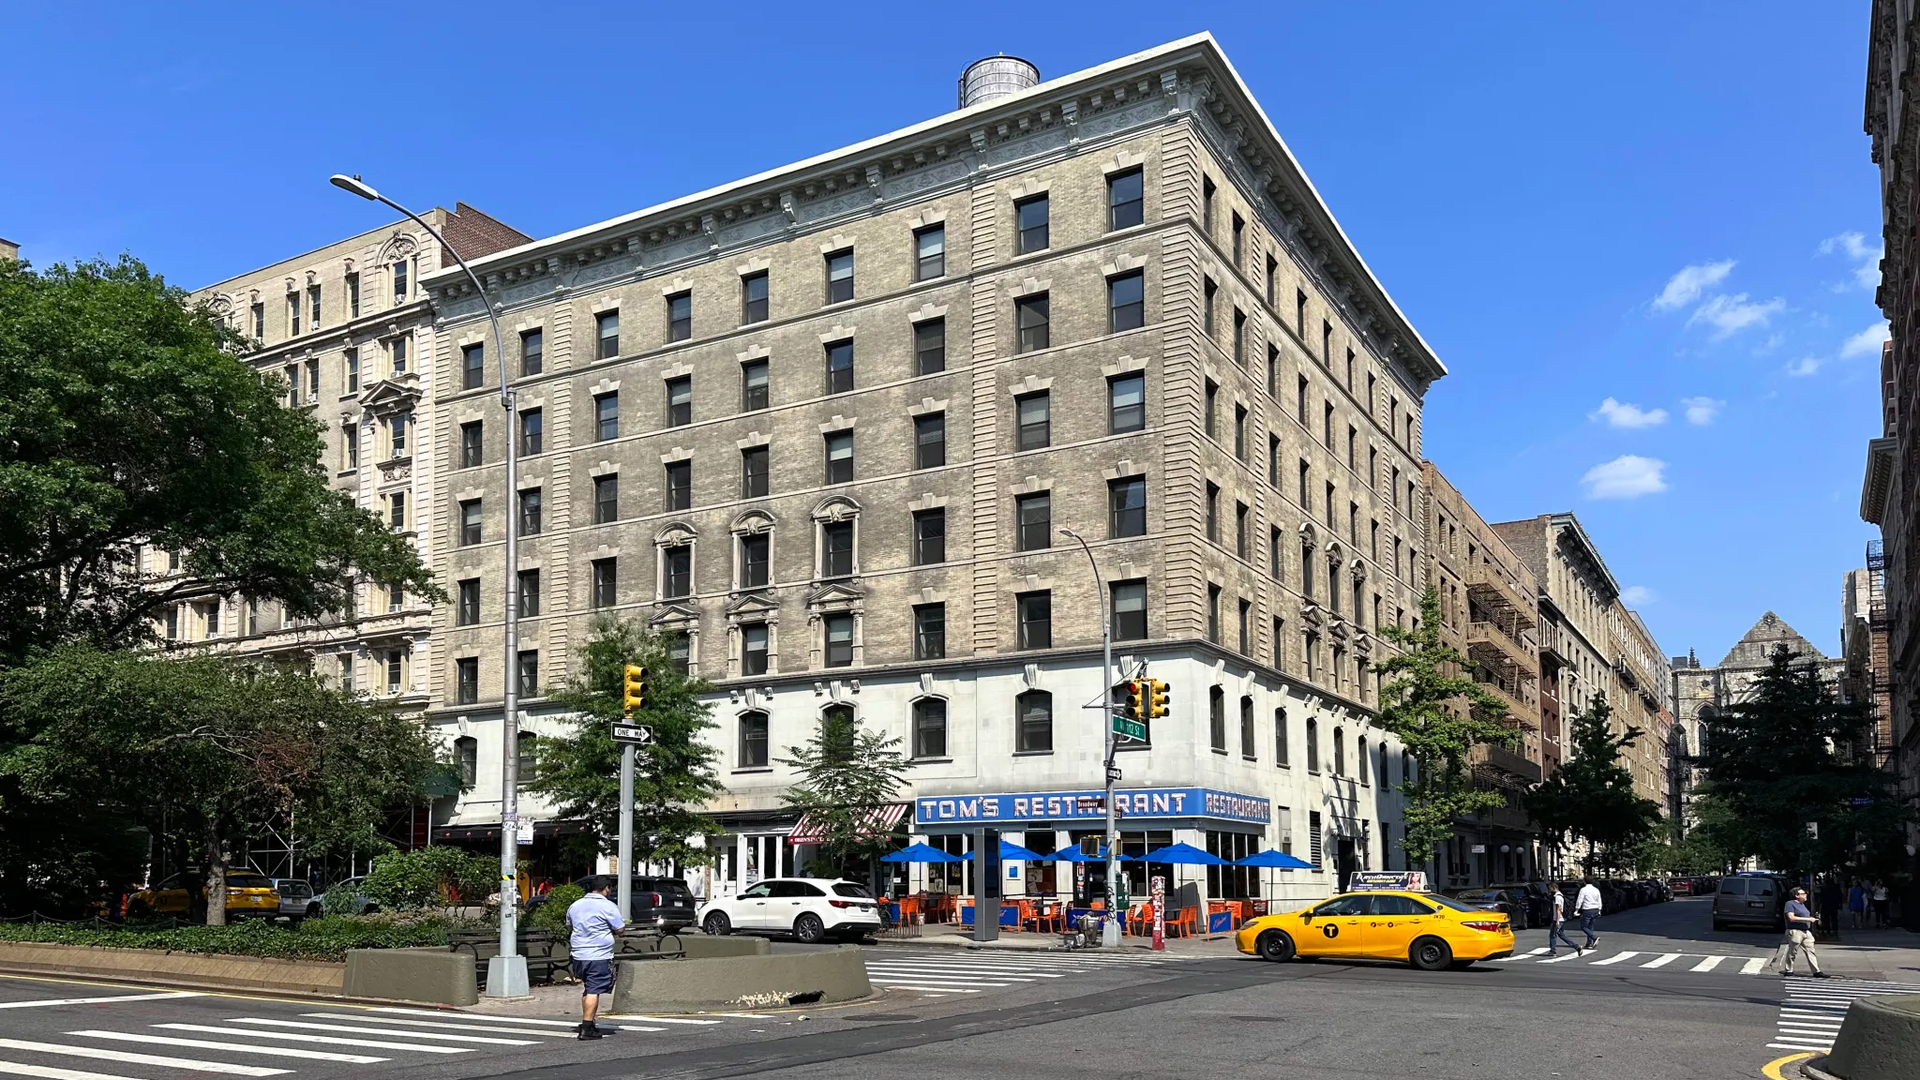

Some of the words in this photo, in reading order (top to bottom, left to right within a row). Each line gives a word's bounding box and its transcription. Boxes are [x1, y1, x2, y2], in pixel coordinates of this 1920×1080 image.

[617, 728, 630, 737] ONE
[634, 730, 646, 739] WAY
[1135, 725, 1140, 736] St
[921, 796, 999, 819] TOM'S
[1205, 793, 1269, 819] RESTAURANT
